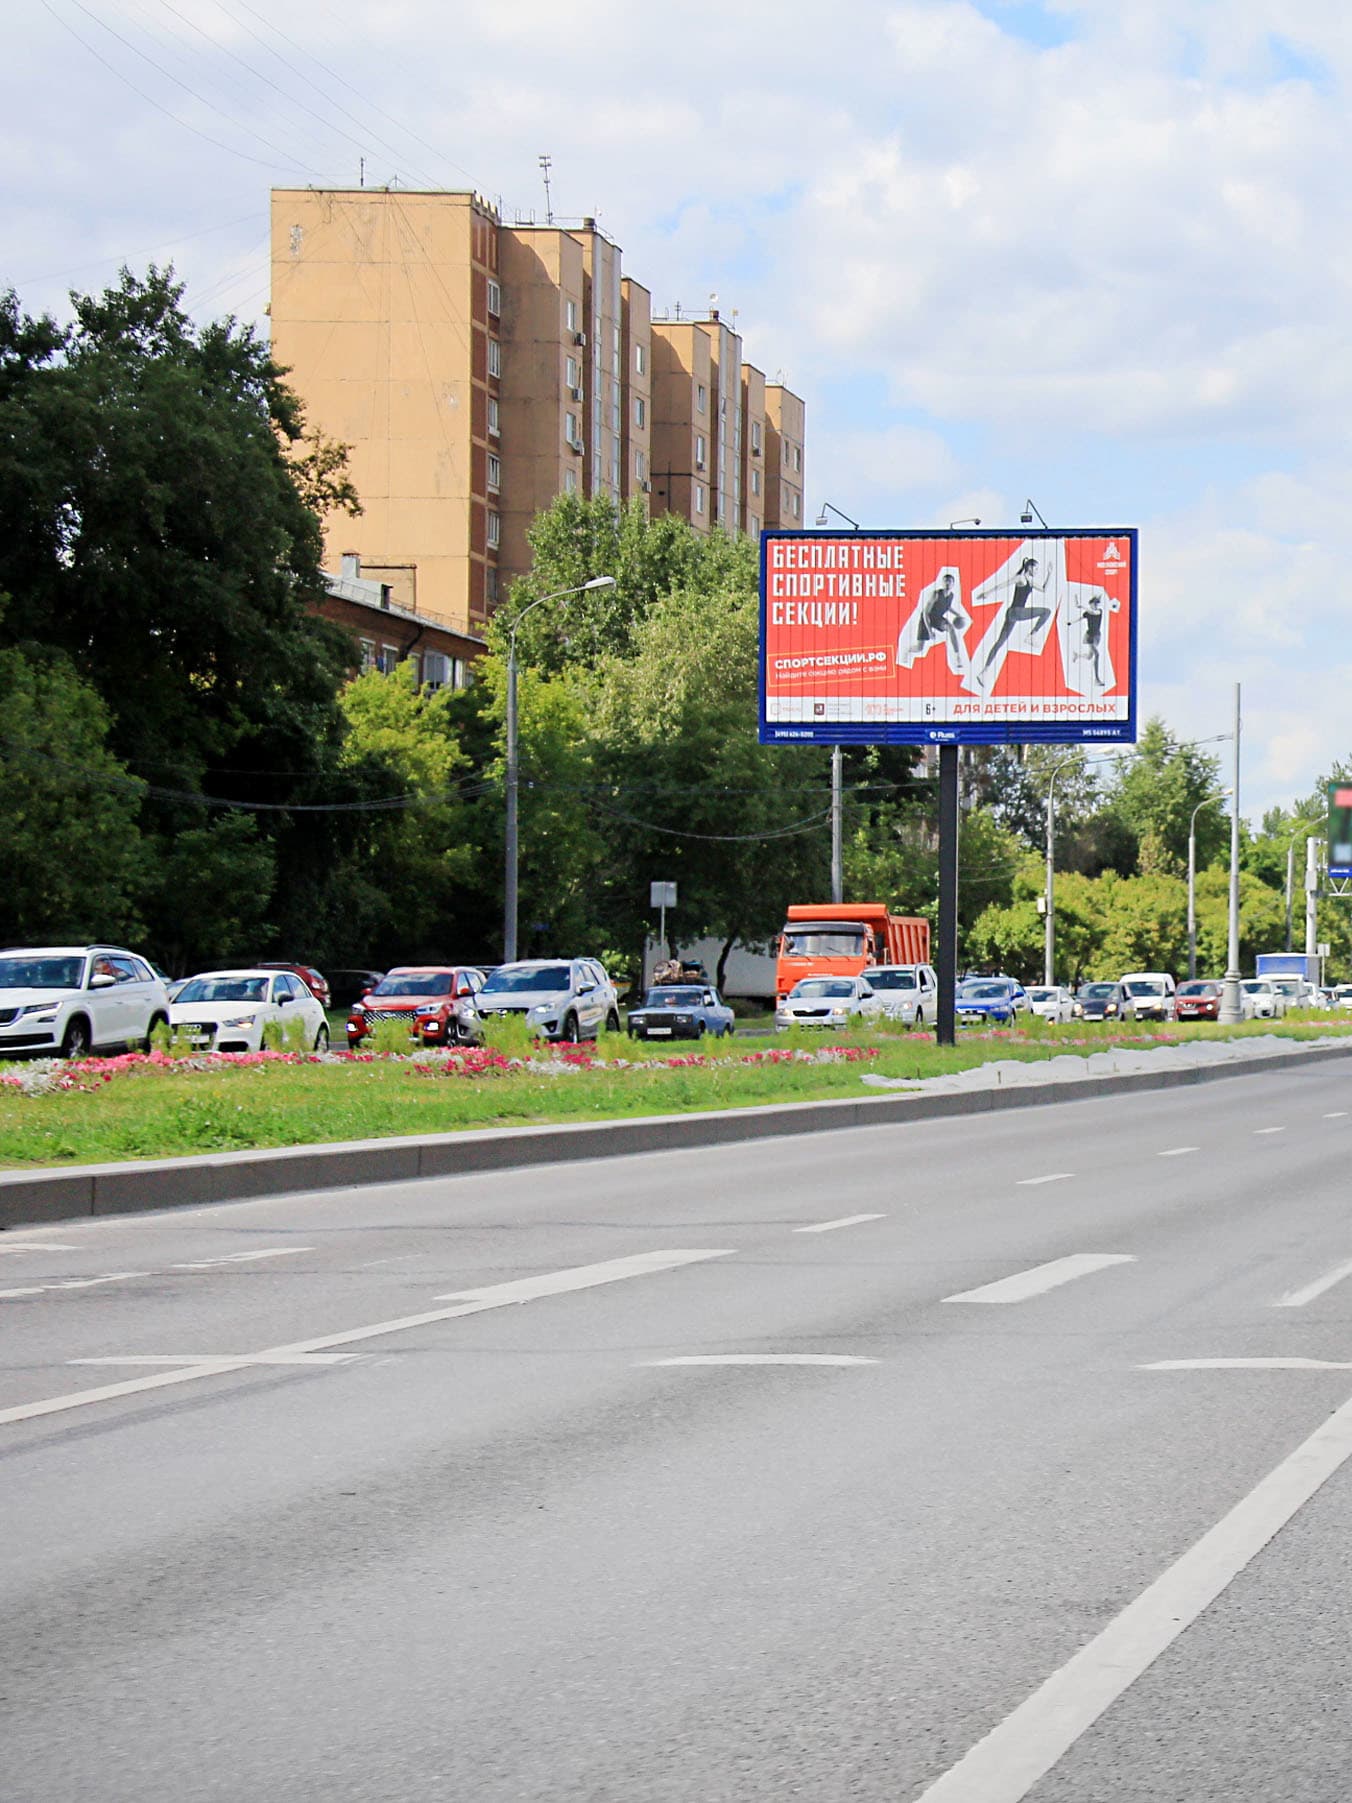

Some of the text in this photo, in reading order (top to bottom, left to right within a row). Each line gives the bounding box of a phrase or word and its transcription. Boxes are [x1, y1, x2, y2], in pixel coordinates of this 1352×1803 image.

[772, 545, 903, 568] БЕСПЛАТНЫЕ
[772, 574, 906, 597] СПОРТИВНЫЕ
[772, 602, 858, 628] СЕКЦИИ!
[774, 651, 887, 669] СПОРТСЕКЦИИ.РФ
[925, 704, 936, 715] 6+
[953, 701, 1116, 714] ДЛЯ ДЕТЕЙ И ВЗРОСЛЫХ
